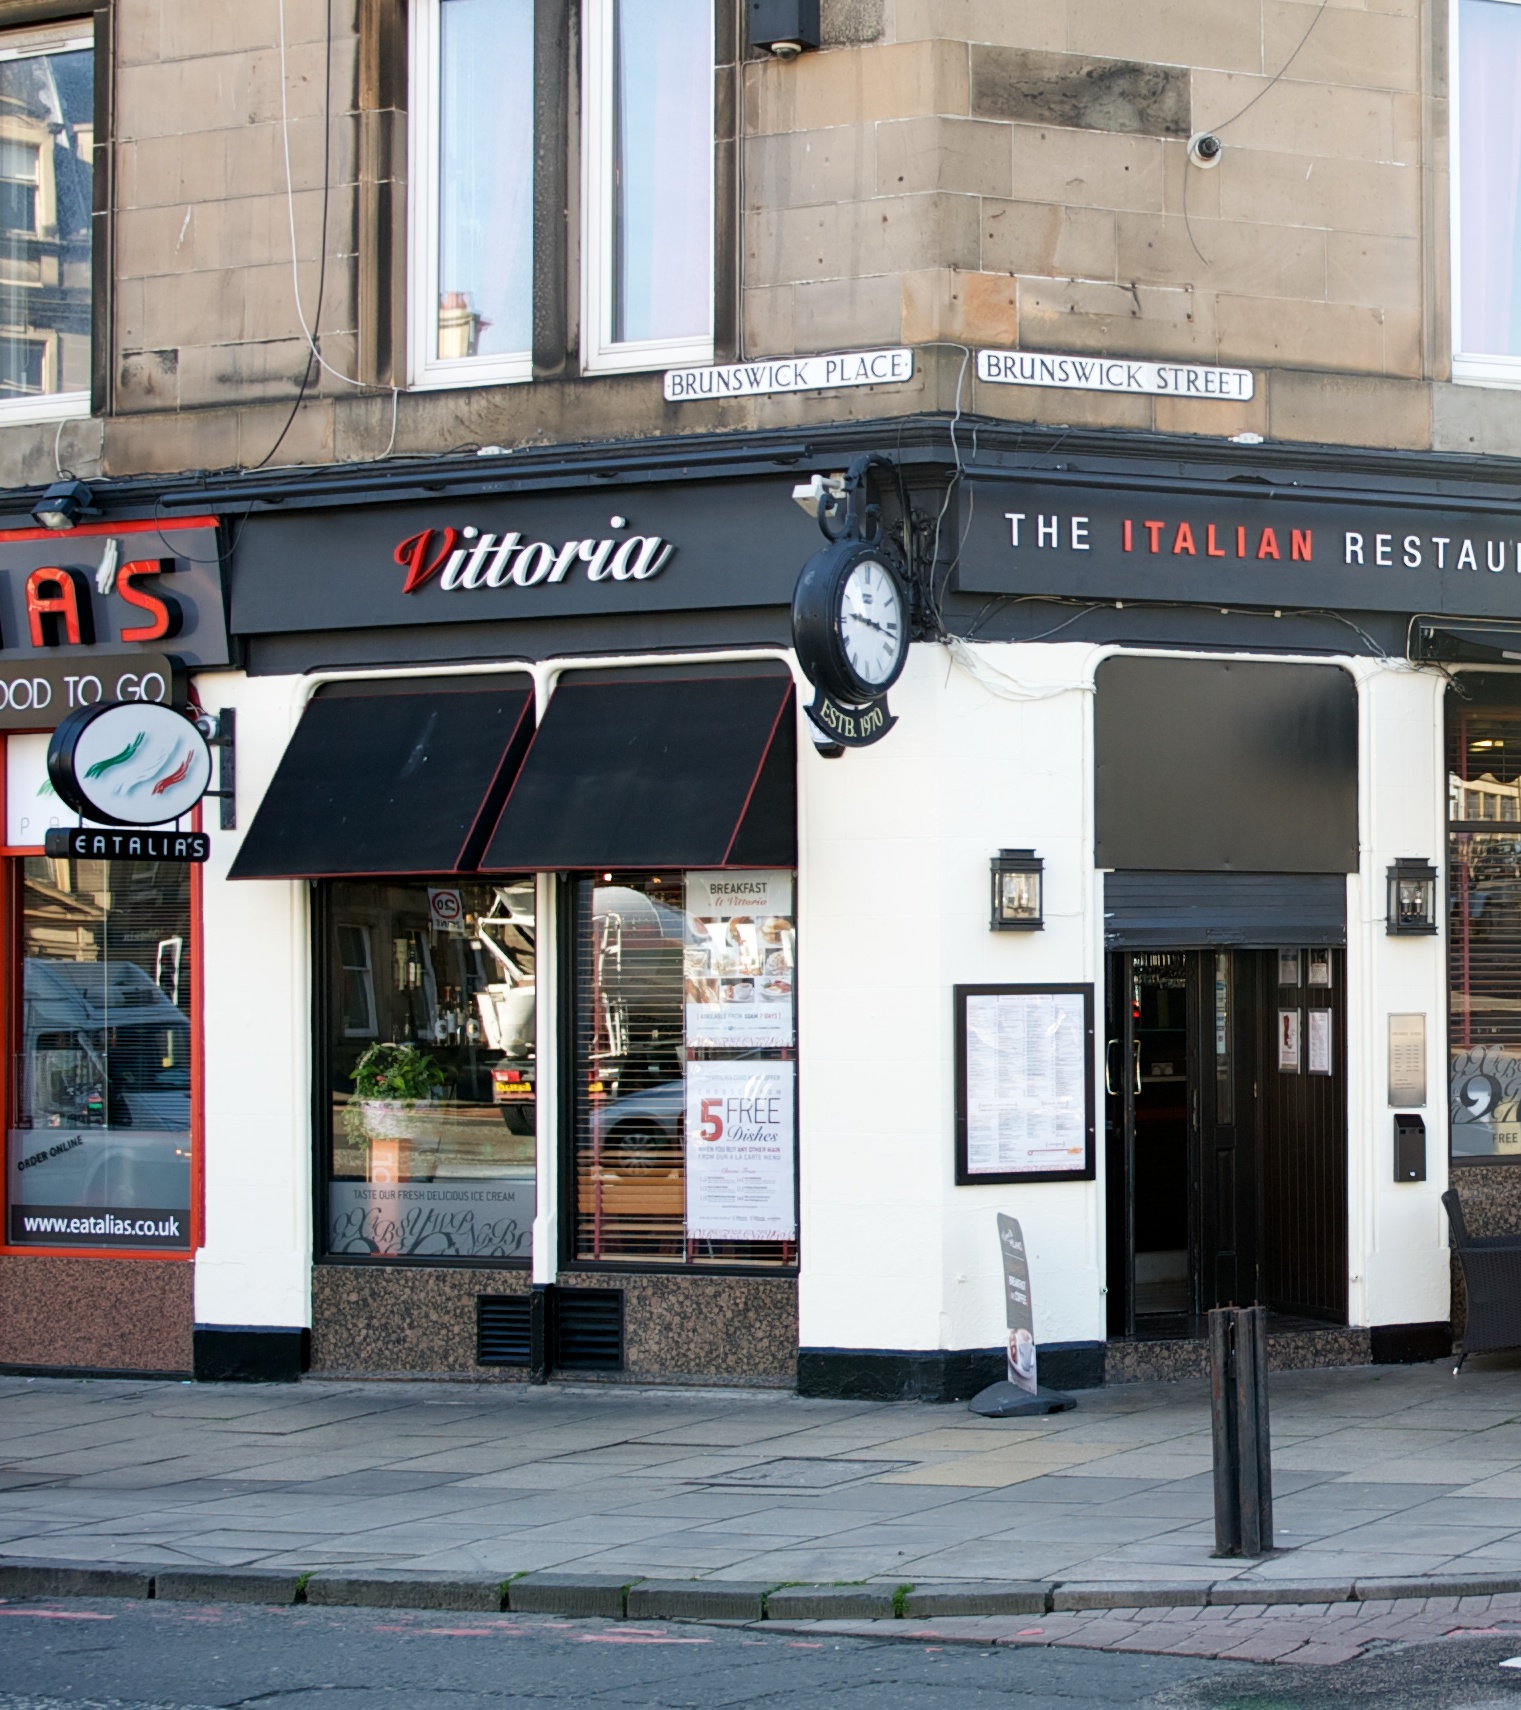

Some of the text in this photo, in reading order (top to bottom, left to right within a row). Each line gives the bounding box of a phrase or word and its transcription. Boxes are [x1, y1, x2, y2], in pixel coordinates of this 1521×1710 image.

[671, 354, 903, 396] BRUNSWICK PLACE
[986, 355, 1248, 396] BRUNSWICK STREET
[1005, 513, 1091, 550] THE
[1123, 519, 1314, 561] ITALIAN
[393, 515, 675, 594] Vittoria
[64, 675, 102, 708] TO
[117, 672, 166, 702] GO
[859, 708, 884, 737] 1970
[75, 833, 205, 857] EATALIA'S
[709, 882, 768, 895] BREAKFAST
[700, 1097, 781, 1142] 5 FREE
[726, 1124, 778, 1142] Dishes
[18, 1135, 84, 1171] ORDER ONLINE
[1492, 1132, 1518, 1143] FREE
[354, 1189, 515, 1202] TASTE OUR FRESH DELICIOUS ICE CREAM
[24, 1214, 180, 1236] www.eatalias.co.uk
